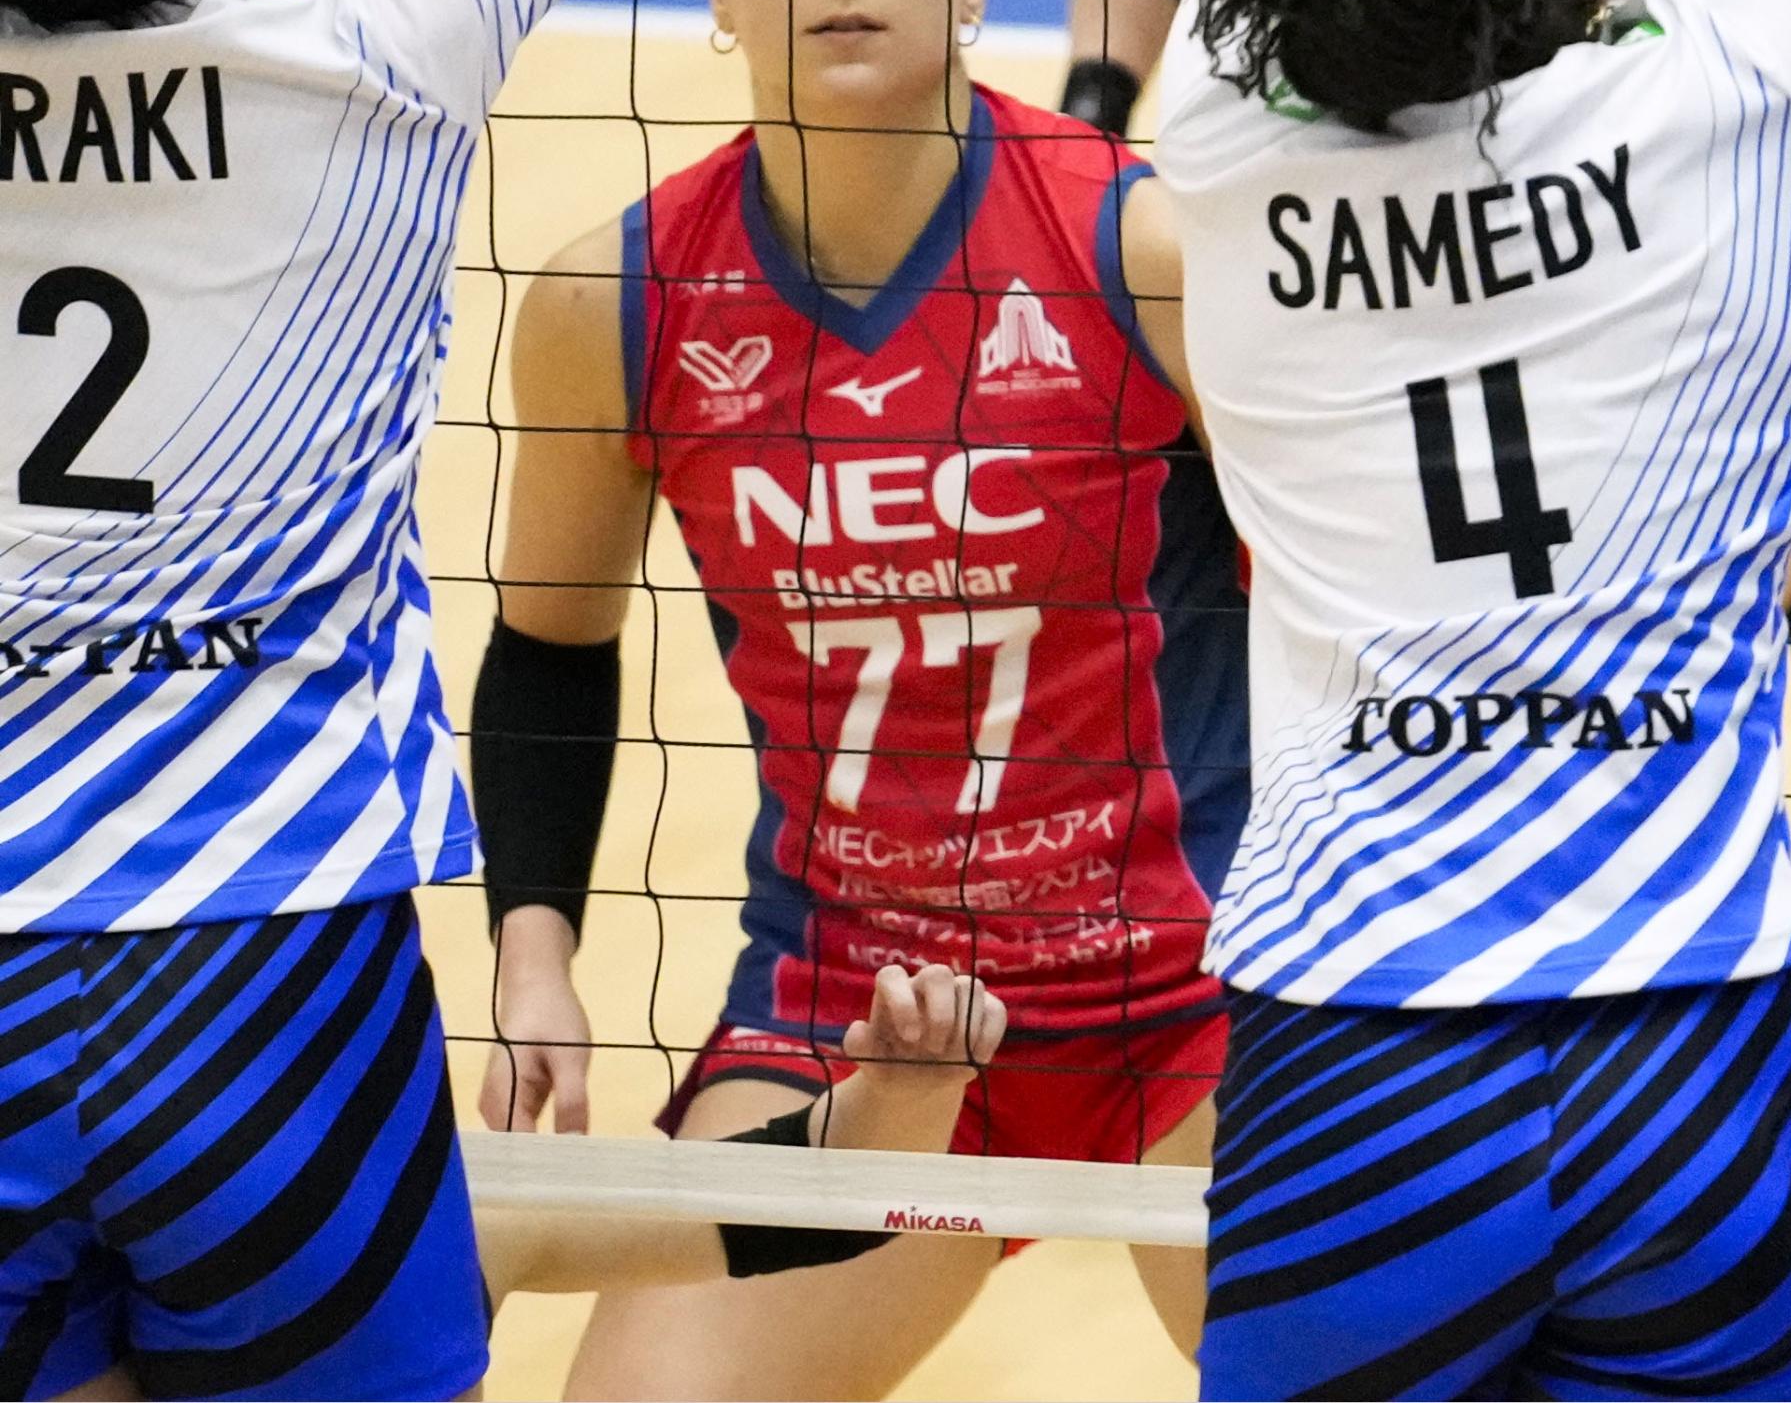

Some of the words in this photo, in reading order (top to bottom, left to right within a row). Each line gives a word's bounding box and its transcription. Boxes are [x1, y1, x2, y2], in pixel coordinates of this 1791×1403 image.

[0, 65, 229, 183] RAKI
[1266, 143, 1644, 310] SAMEDY
[17, 266, 154, 513] 2
[731, 444, 1046, 548] NEC
[1405, 357, 1573, 600] 4
[773, 558, 1019, 610] BluStellar
[785, 606, 1044, 816] 77
[1340, 688, 1691, 758] TOPPAN
